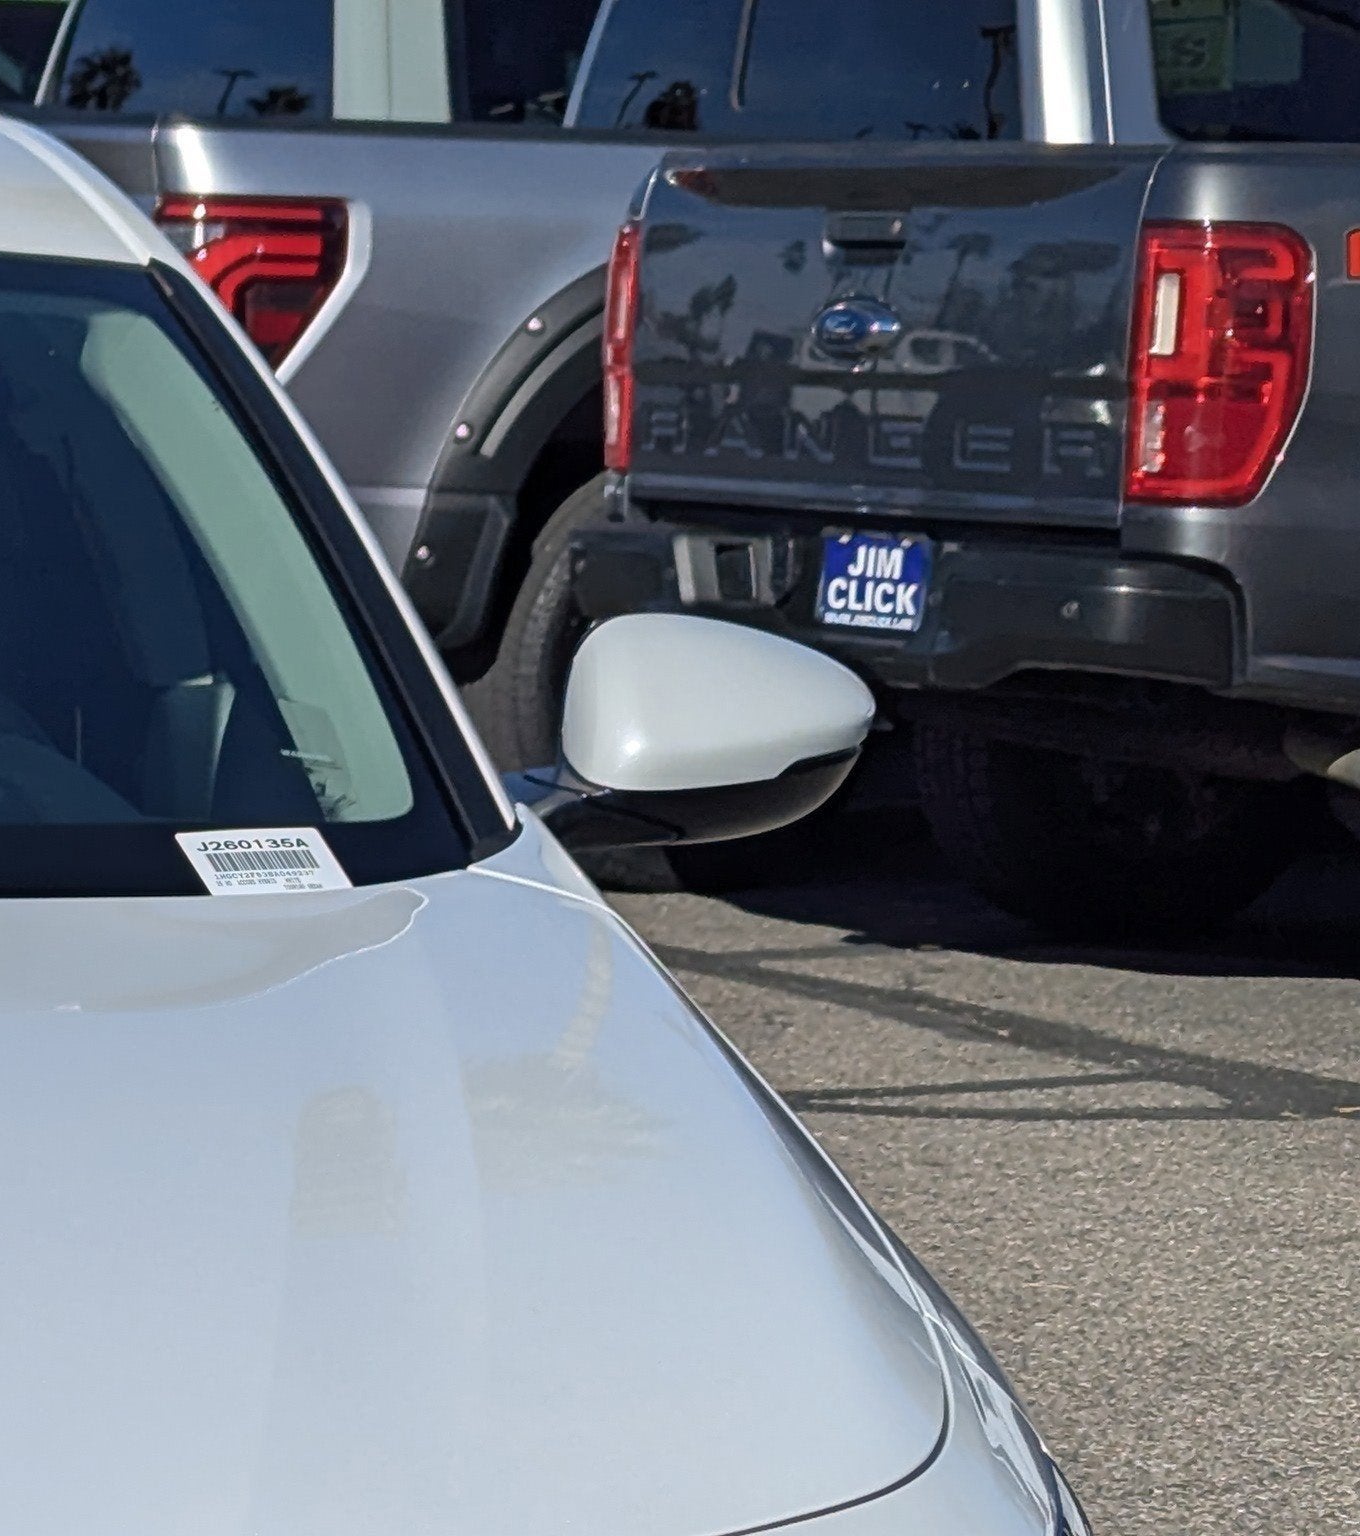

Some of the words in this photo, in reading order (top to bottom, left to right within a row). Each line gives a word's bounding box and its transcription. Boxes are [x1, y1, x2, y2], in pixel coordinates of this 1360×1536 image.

[640, 408, 1107, 479] RANGER
[847, 544, 904, 580] JIM
[827, 576, 919, 616] CLICK
[197, 838, 309, 852] J260135A
